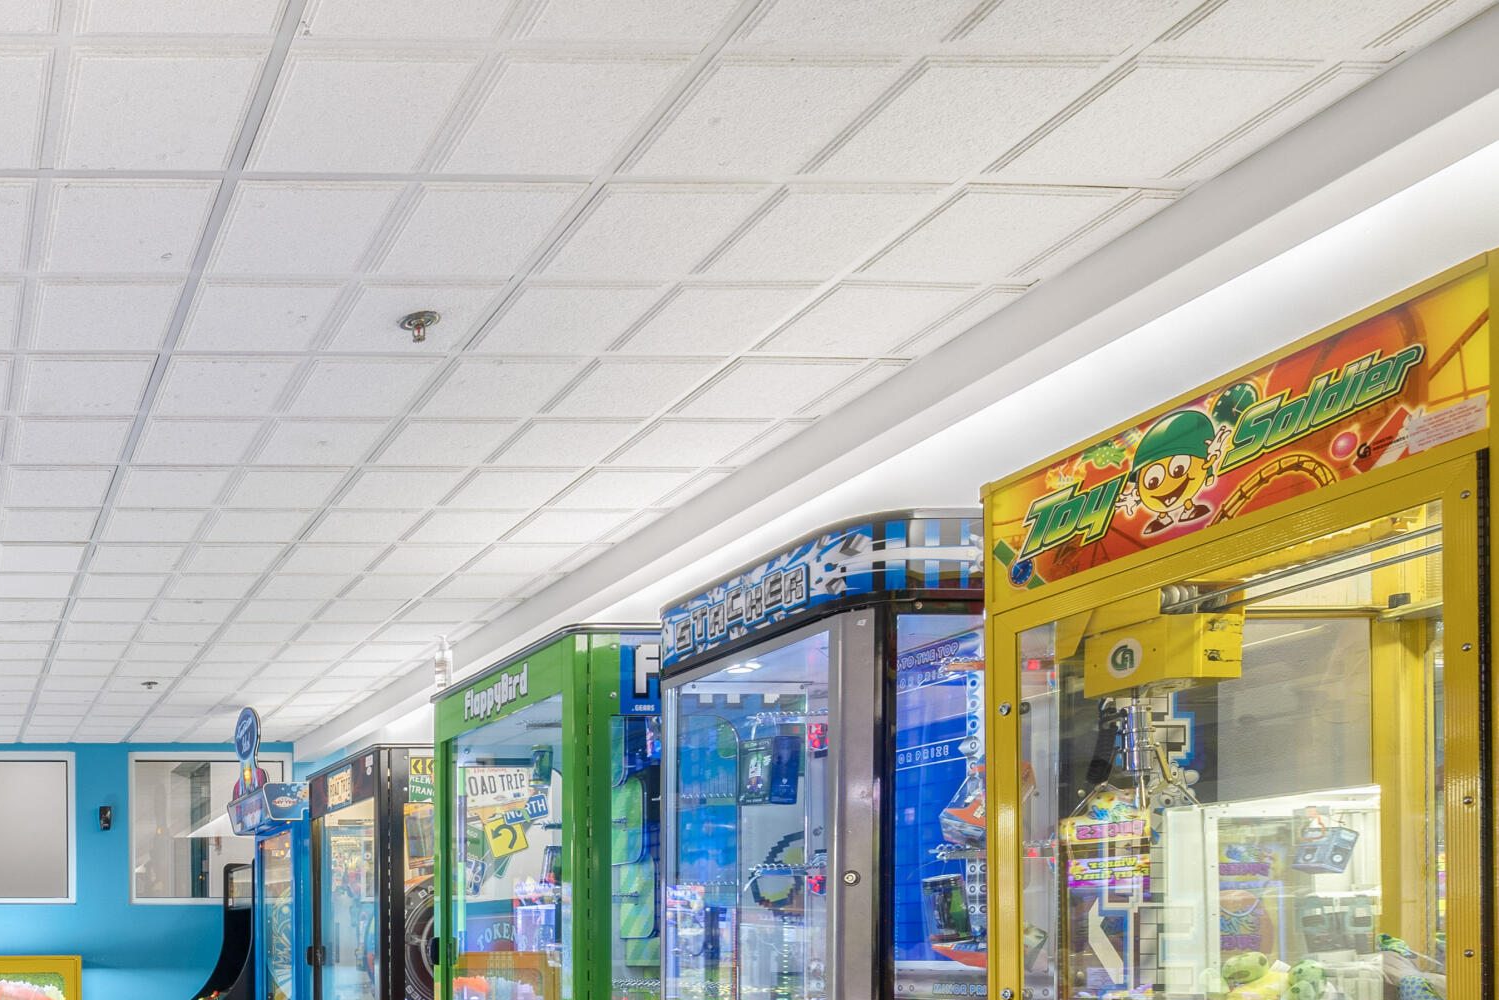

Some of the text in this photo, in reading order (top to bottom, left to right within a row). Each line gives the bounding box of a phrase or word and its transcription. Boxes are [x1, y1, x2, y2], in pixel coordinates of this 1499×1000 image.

[1020, 470, 1130, 558] Toy
[1218, 343, 1426, 476] Soldier
[675, 565, 807, 653] STACKER
[916, 648, 937, 667] THE
[938, 641, 960, 661] TOP
[410, 785, 434, 797] TRAN
[501, 772, 525, 792] TRIP
[933, 983, 966, 996] MINOR
